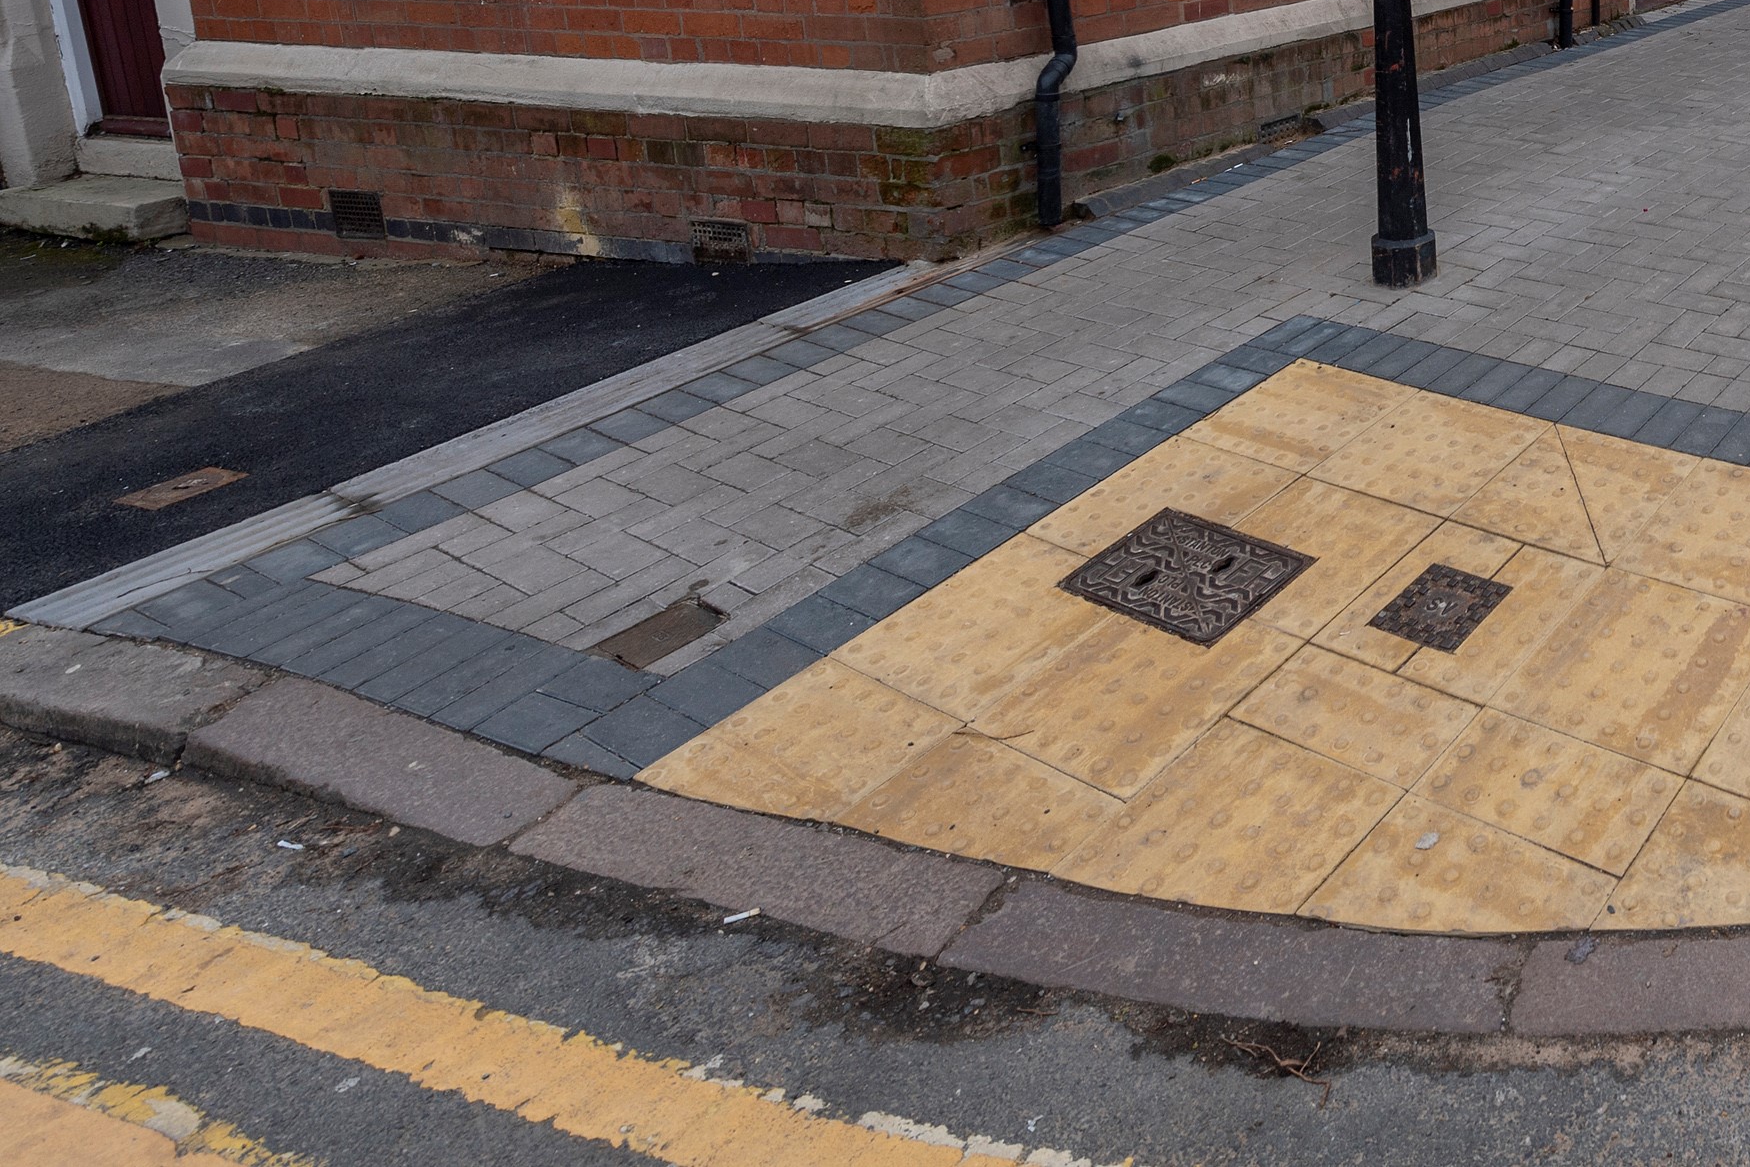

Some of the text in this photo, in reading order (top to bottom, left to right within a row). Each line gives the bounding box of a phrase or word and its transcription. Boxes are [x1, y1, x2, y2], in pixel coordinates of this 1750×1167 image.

[1179, 536, 1230, 559] STANTON
[1184, 554, 1210, 570] PLC
[1158, 573, 1184, 589] PLC
[1139, 586, 1196, 613] STANTON
[1425, 597, 1459, 616] SV
